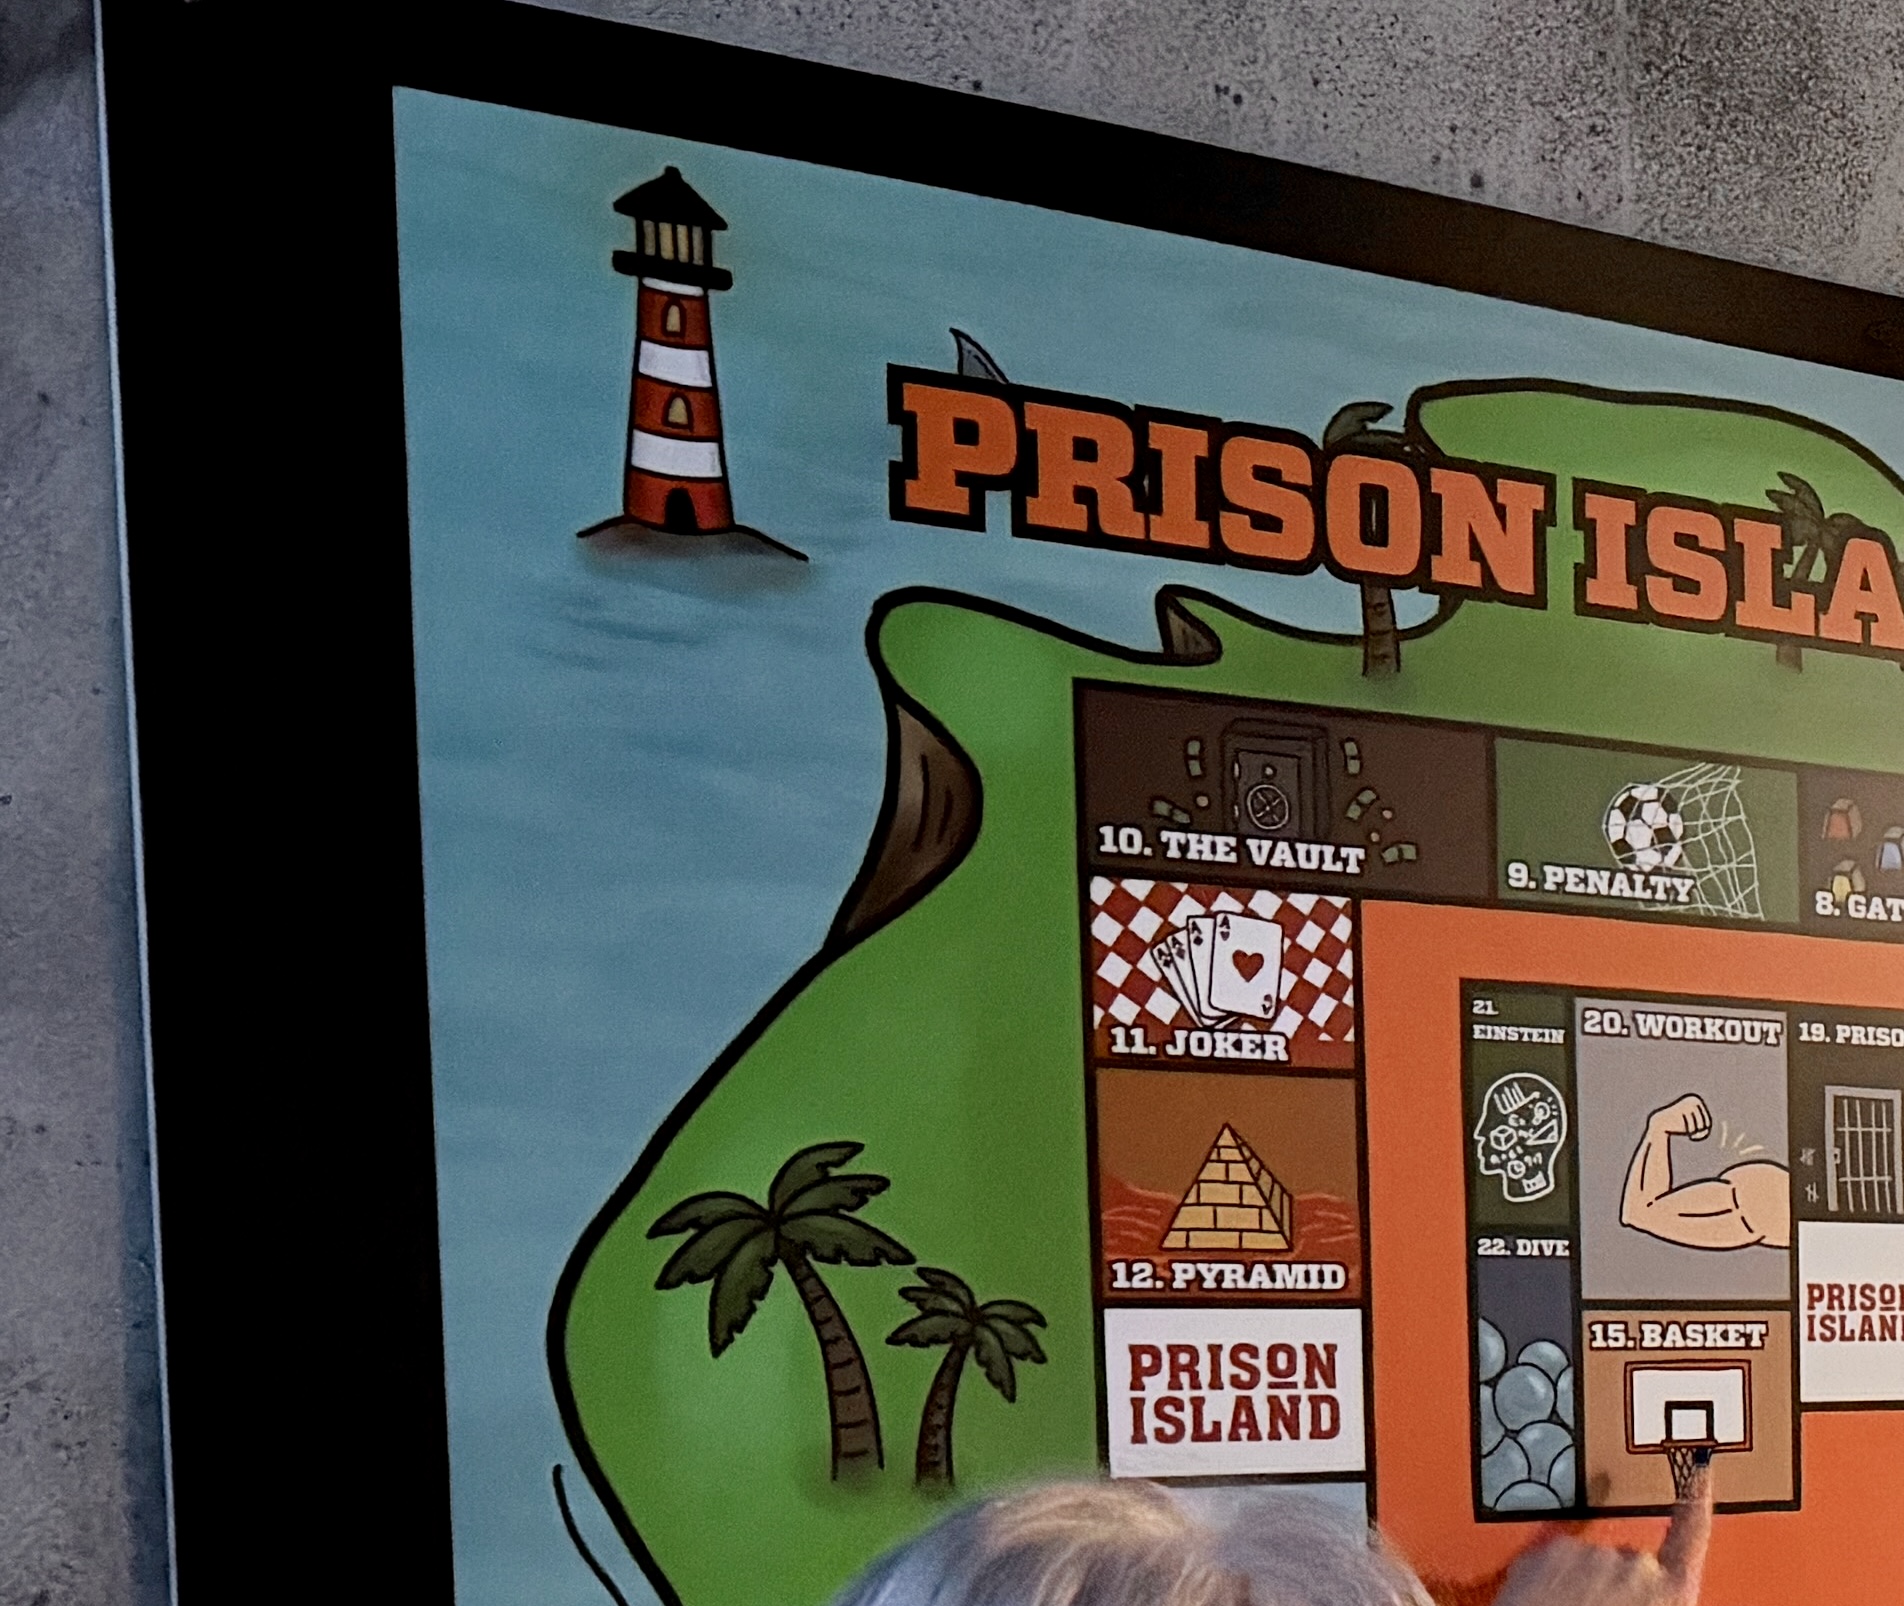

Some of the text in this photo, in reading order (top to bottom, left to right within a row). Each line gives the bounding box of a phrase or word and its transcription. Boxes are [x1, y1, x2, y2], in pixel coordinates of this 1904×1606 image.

[892, 370, 1553, 604] PRISON
[1099, 825, 1366, 874] 10. THE VAULT
[1507, 861, 1698, 905] 9. PENALTY
[1815, 892, 1843, 921] 8.
[1111, 1026, 1289, 1062] 11. JOKER
[1473, 1024, 1566, 1045] EINSTEIN
[1583, 1009, 1784, 1045] 20. WORKOUT
[1800, 1021, 1831, 1045] 19.
[1477, 1238, 1570, 1258] 22. DIVE
[1111, 1261, 1347, 1292] 12. PYRAMID
[1589, 1321, 1768, 1350] 15. BASKET
[1129, 1342, 1339, 1392] PRISON
[1129, 1394, 1342, 1445] ISLAND
